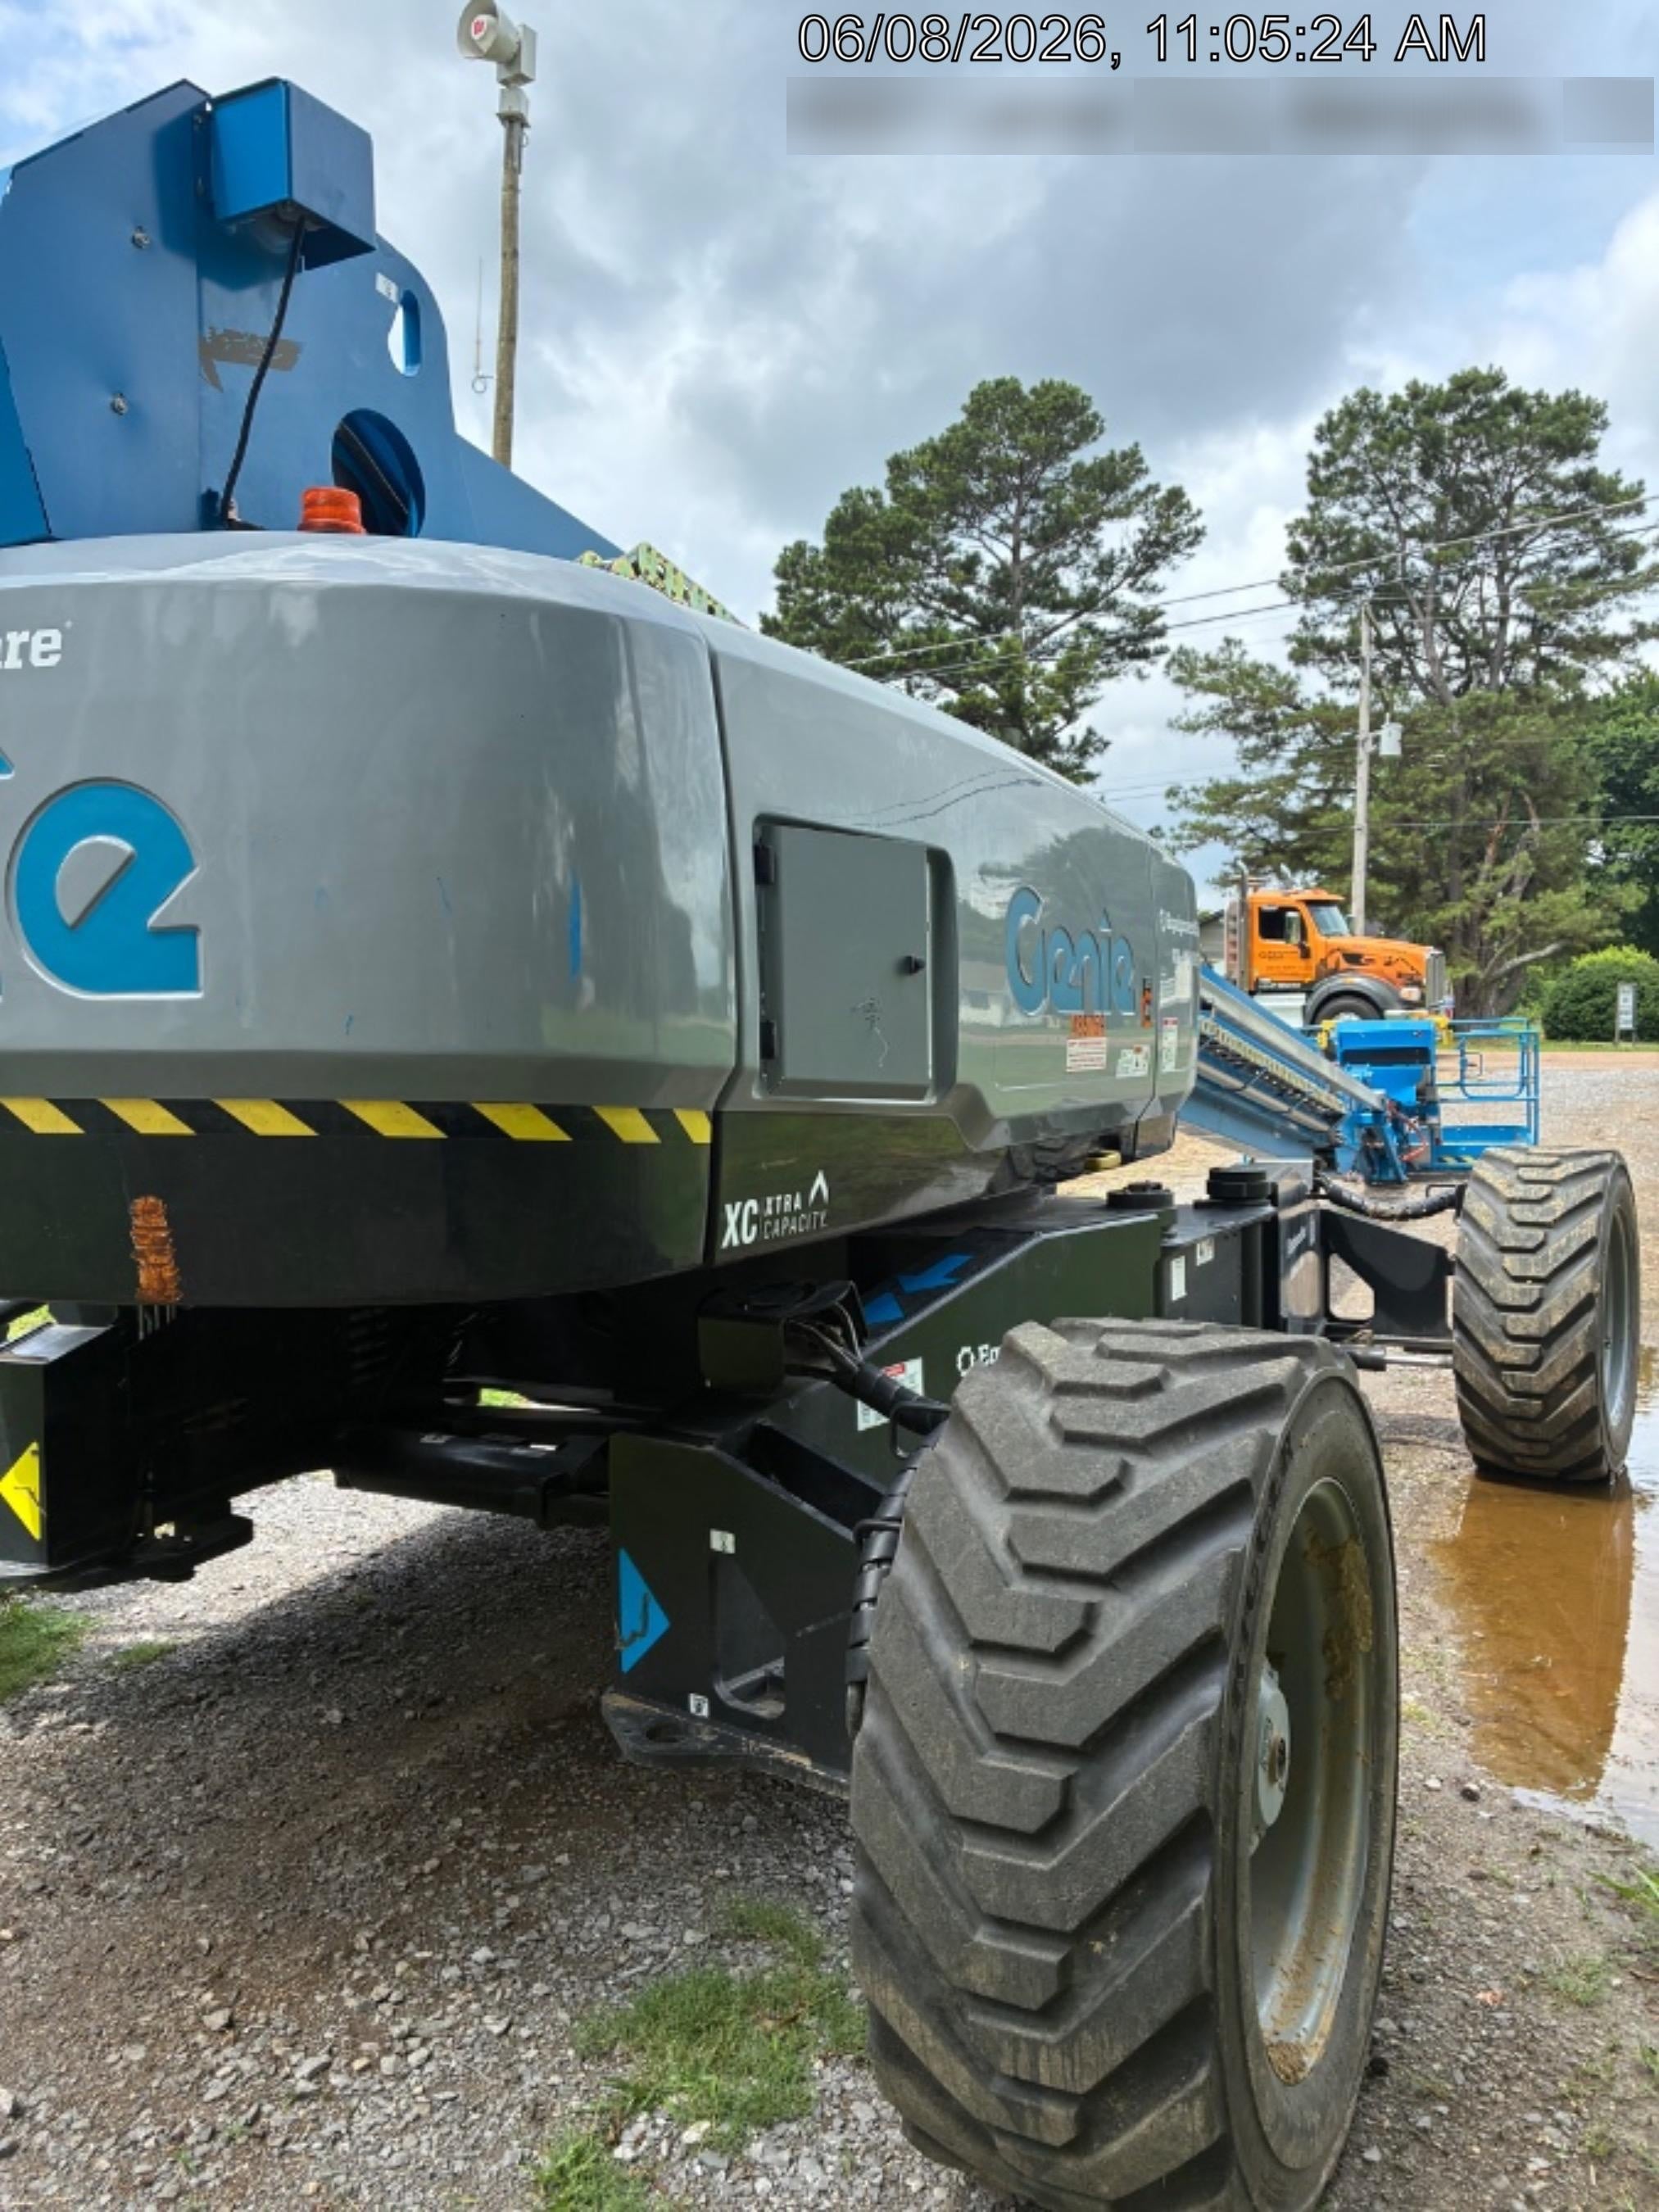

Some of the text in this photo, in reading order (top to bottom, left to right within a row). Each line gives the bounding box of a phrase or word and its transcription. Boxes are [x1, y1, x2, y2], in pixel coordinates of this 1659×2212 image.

[0, 629, 62, 669] re
[1005, 886, 1136, 1016] Genie
[721, 1198, 759, 1249] XC
[764, 1191, 802, 1217] XTRA
[763, 1209, 828, 1240] CAPACITY
